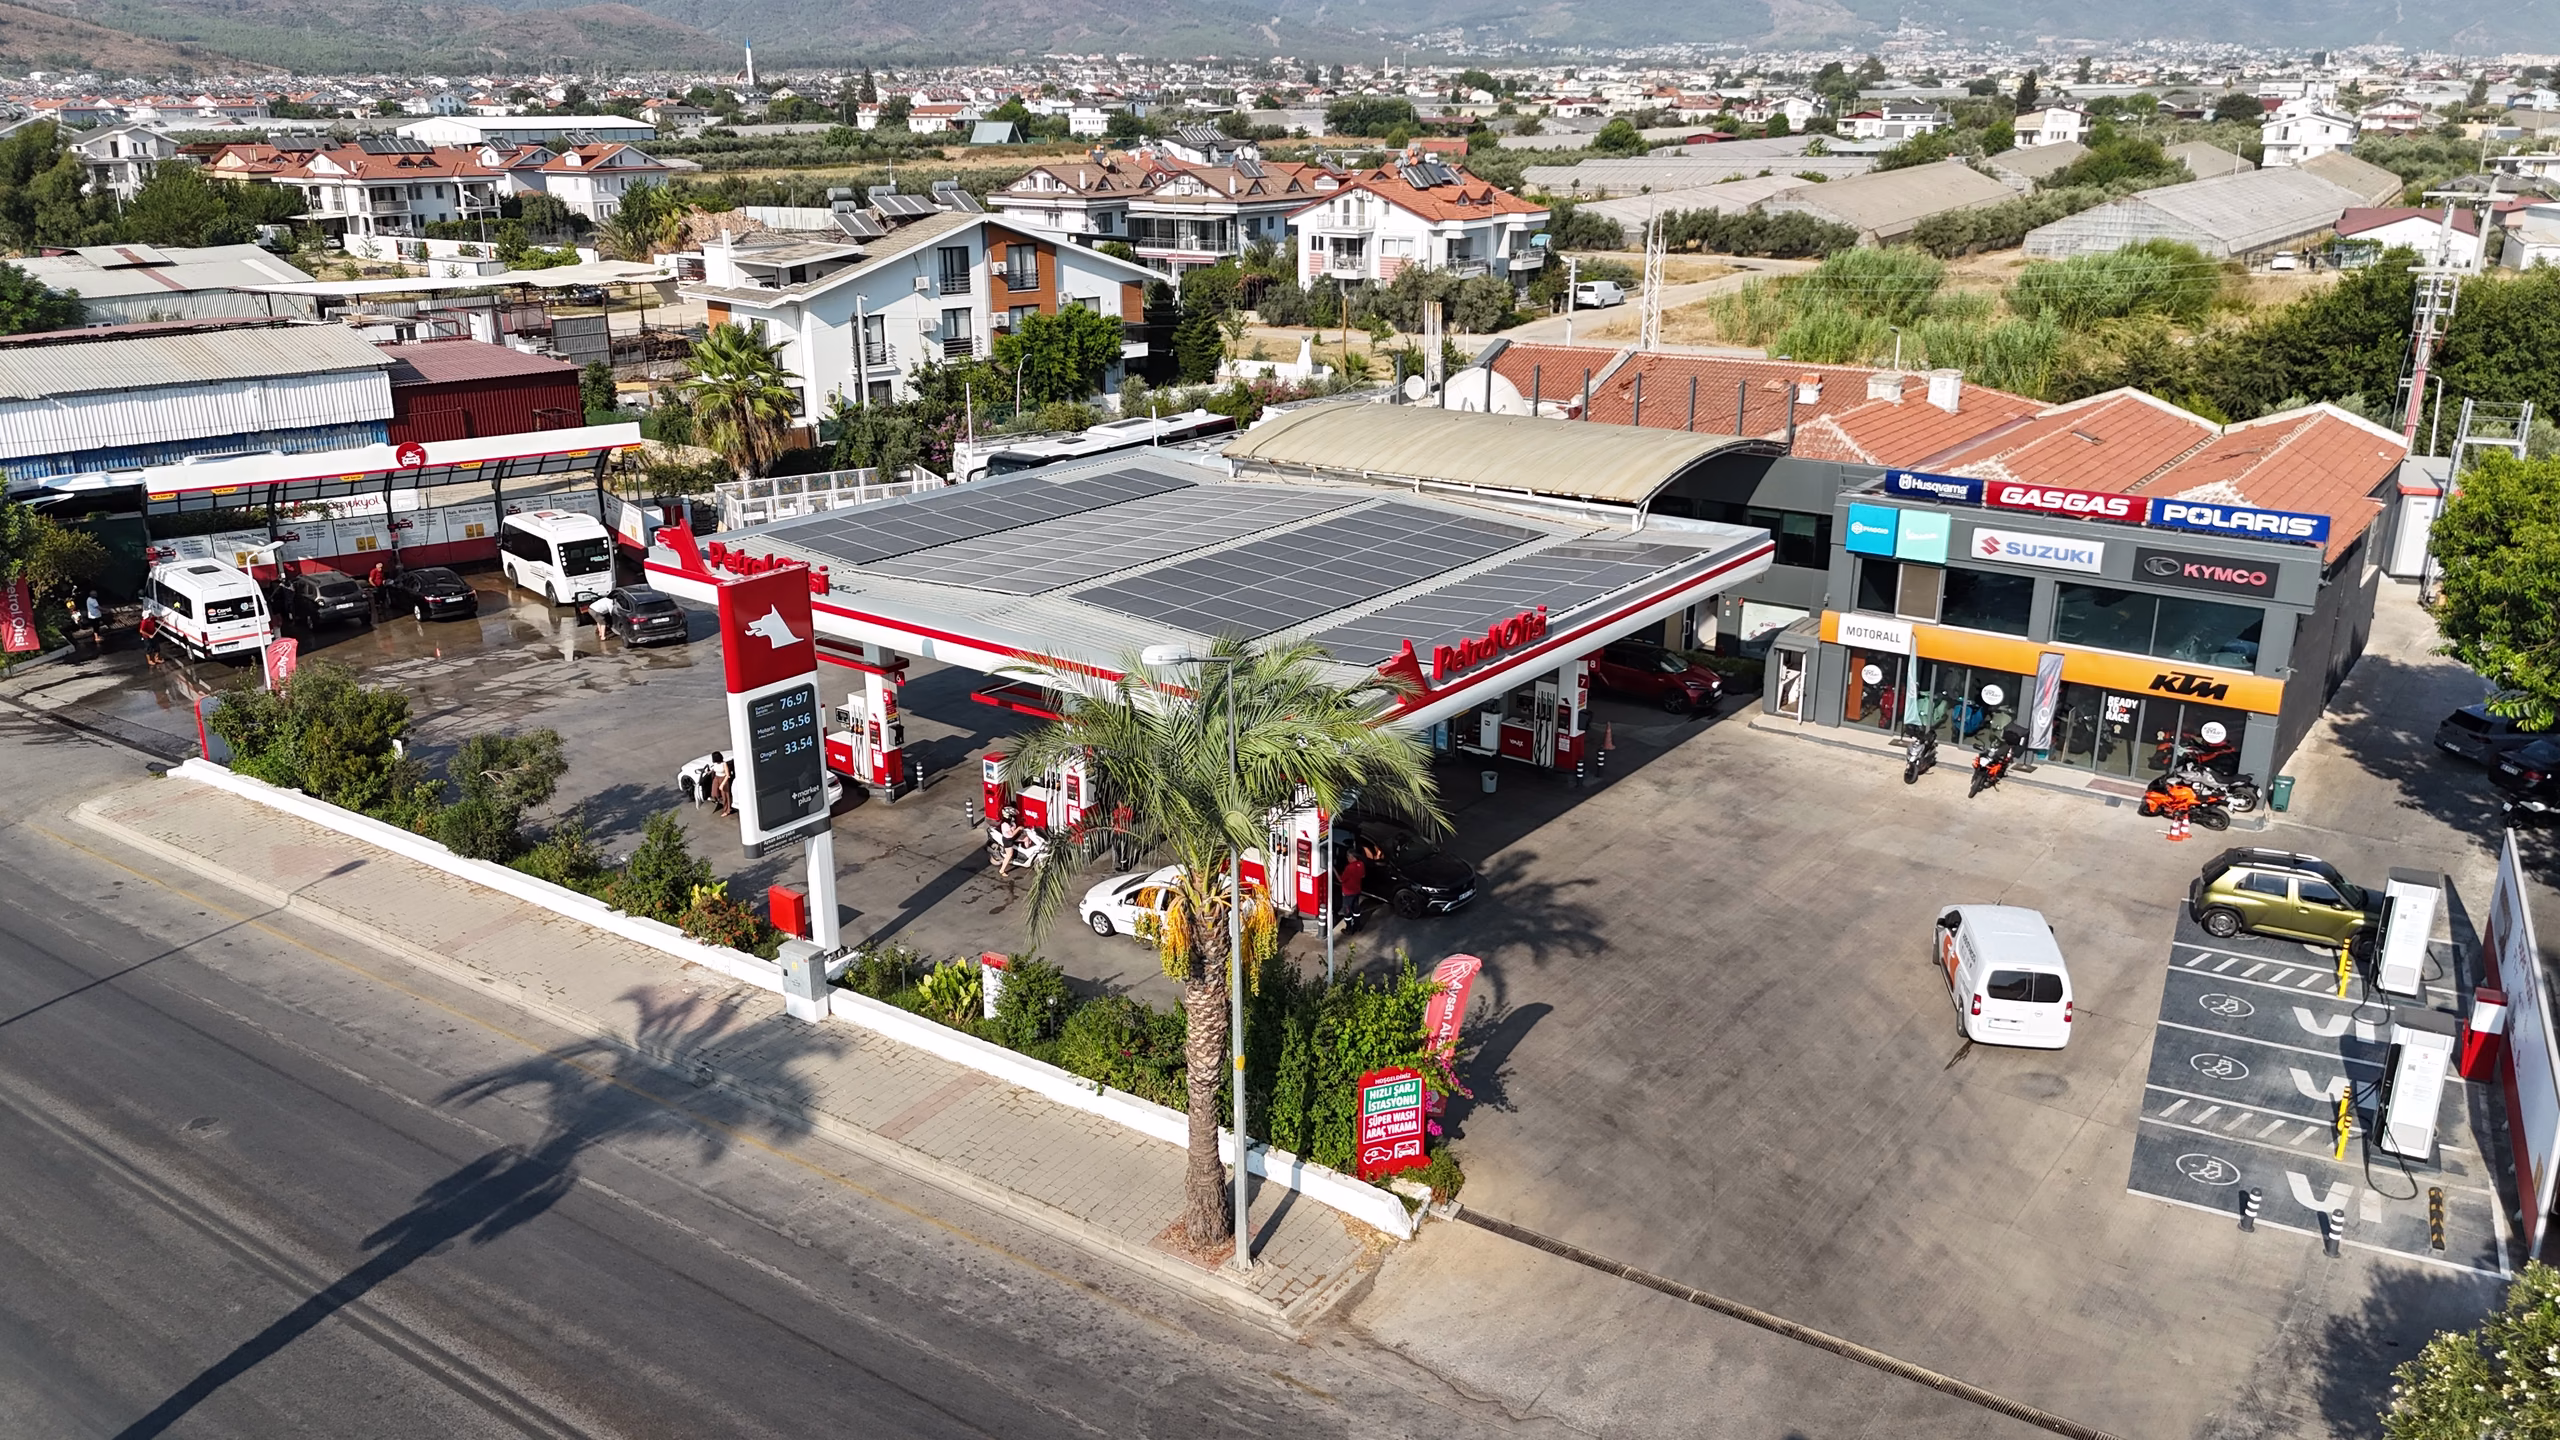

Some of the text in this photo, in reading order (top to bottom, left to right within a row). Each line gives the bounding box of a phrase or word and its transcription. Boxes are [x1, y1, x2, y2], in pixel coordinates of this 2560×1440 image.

[1912, 478, 1966, 495] Husqvarna
[2000, 487, 2131, 516] GASGAS
[2163, 504, 2315, 537] POLARIS
[2006, 542, 2094, 564] SUZUKI
[2184, 563, 2267, 586] KYMCO
[1846, 626, 1901, 643] MOTORALL
[1590, 660, 1596, 668] 8
[896, 674, 902, 682] 6
[1580, 678, 1586, 686] 7
[2149, 671, 2229, 701] KTM
[780, 691, 808, 710] 76.97
[883, 692, 889, 701] 5
[2107, 696, 2139, 710] READY
[2105, 712, 2131, 724] RACE
[2107, 705, 2120, 713] TO
[782, 712, 811, 731] 85.56
[784, 735, 813, 755] 33.54
[797, 785, 820, 798] market
[798, 796, 812, 807] plus
[1443, 980, 1464, 1020] Aysan
[1369, 1082, 1416, 1100] HIZLI ŞARJ
[1368, 1094, 1417, 1113] İSTASYONU
[1368, 1112, 1393, 1128] SÜPER
[1393, 1110, 1416, 1122] WASH
[1366, 1120, 1417, 1139] ARAÇ YIKAMA
